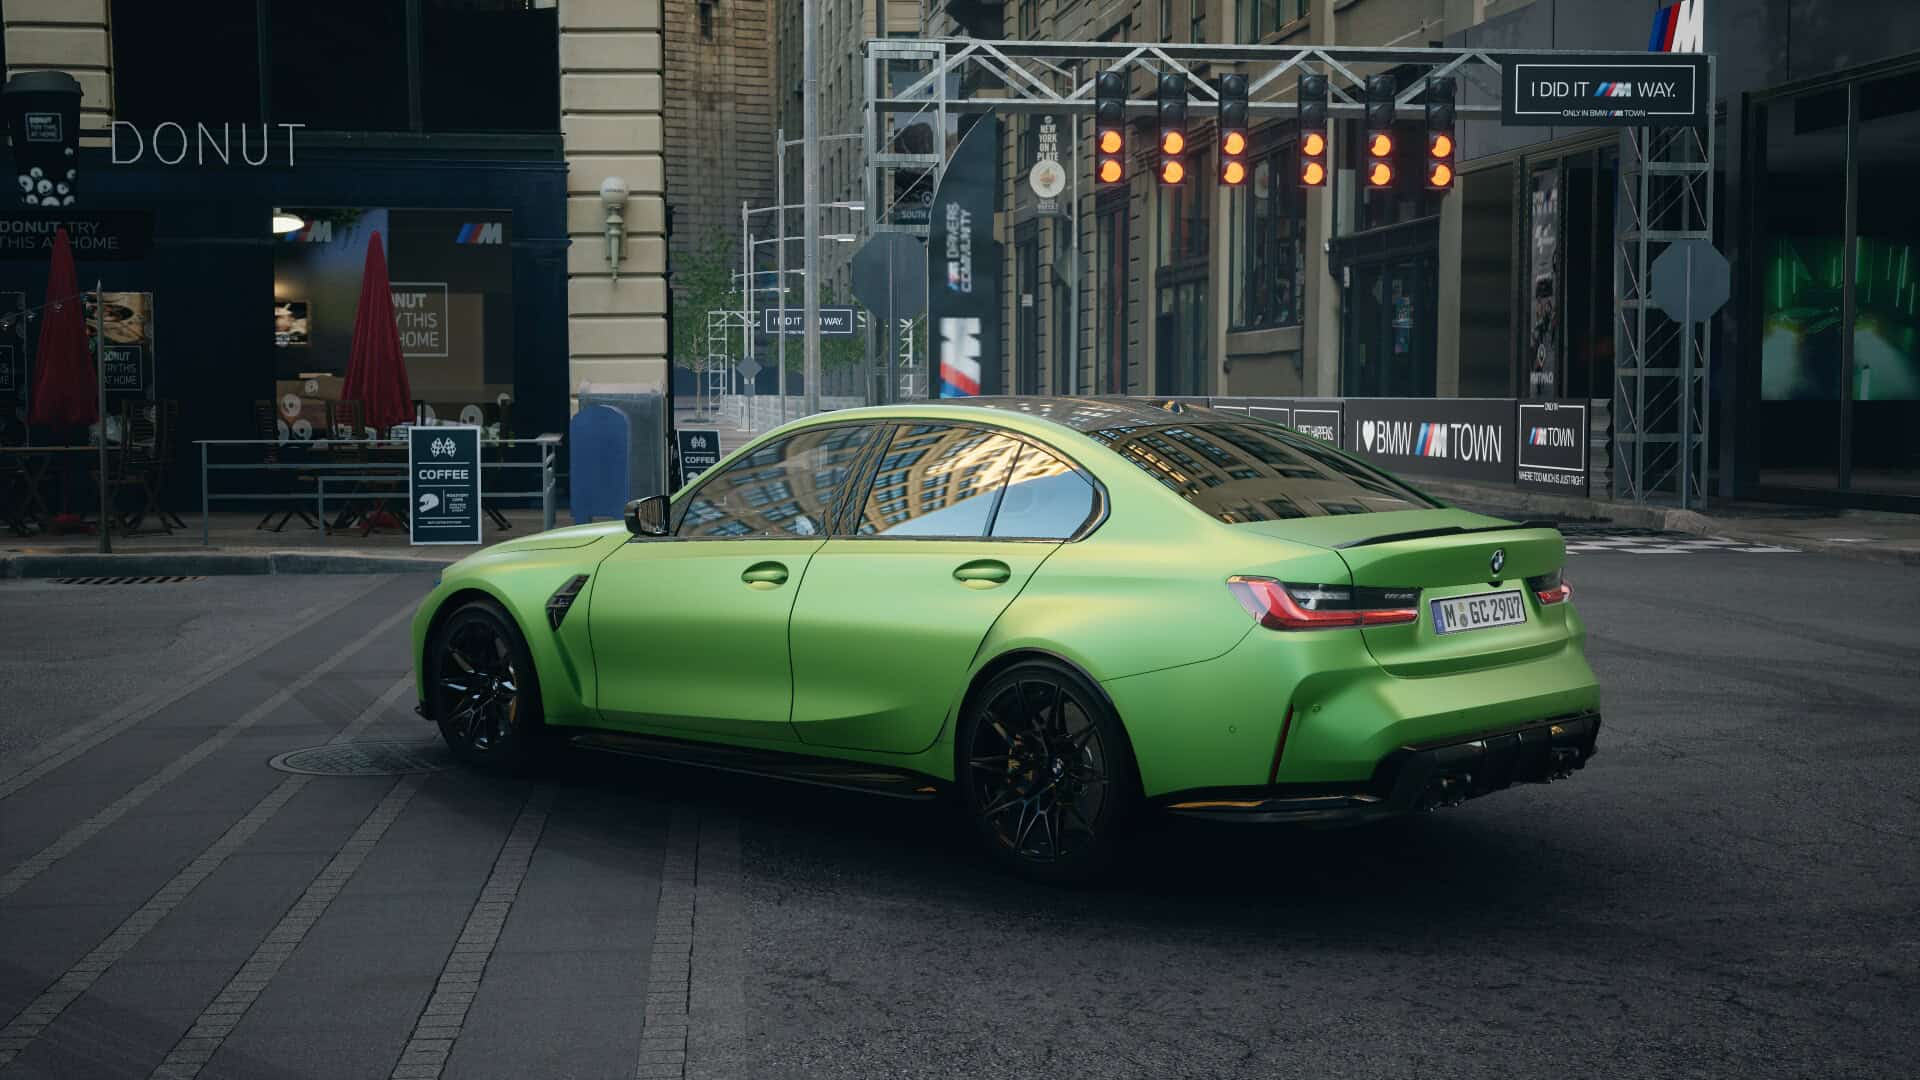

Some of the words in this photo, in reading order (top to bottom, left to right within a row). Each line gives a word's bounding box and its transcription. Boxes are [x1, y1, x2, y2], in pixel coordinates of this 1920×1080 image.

[1531, 81, 1535, 97] I
[1540, 81, 1569, 97] DID
[1574, 81, 1590, 97] IT
[1637, 81, 1676, 98] WAY.
[1624, 109, 1646, 118] TOWN
[1040, 124, 1056, 133] NEW
[111, 121, 306, 166] DONUT
[1040, 143, 1050, 152] ON
[1051, 143, 1057, 152] A
[41, 236, 57, 249] A
[391, 292, 427, 308] NUT
[402, 312, 438, 328] THIS
[1376, 420, 1413, 456] BMW
[1450, 422, 1502, 463] TOWN
[1547, 427, 1575, 447] TOWN
[684, 456, 715, 464] COFFEE
[418, 469, 469, 480] COFFEE
[1444, 603, 1456, 628] M
[1469, 600, 1490, 624] GC
[1490, 596, 1521, 621] 2907
